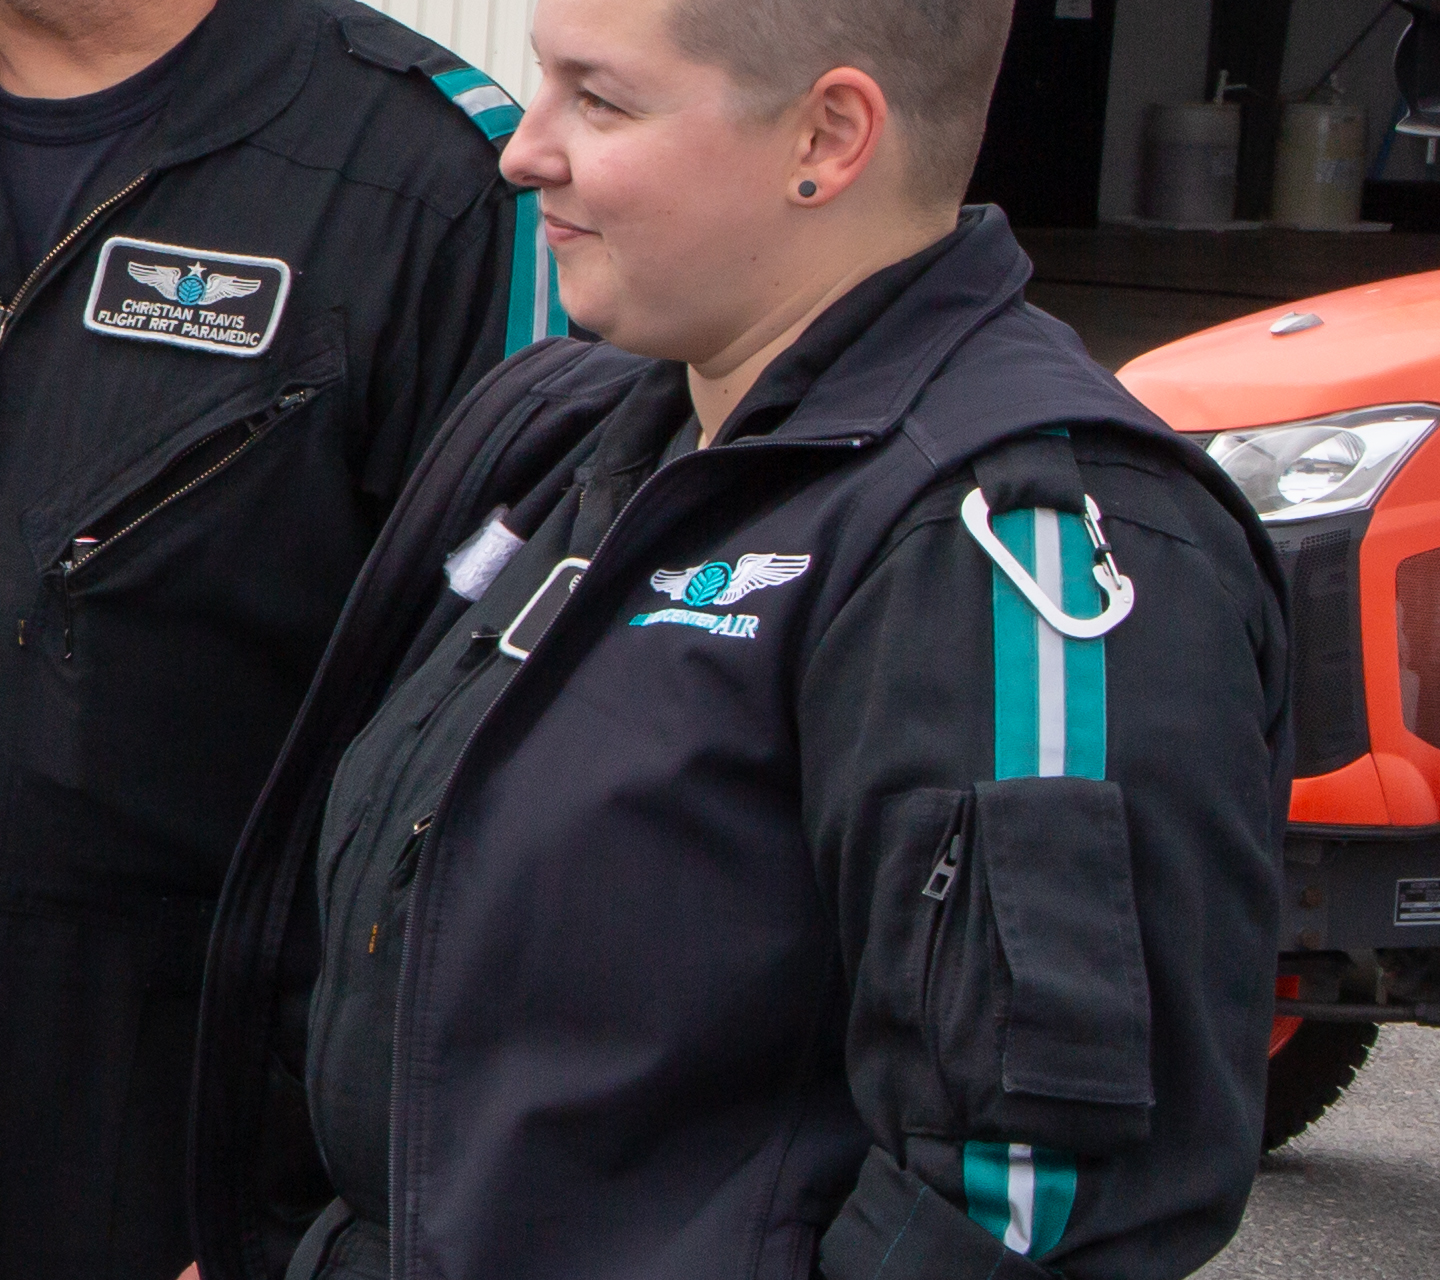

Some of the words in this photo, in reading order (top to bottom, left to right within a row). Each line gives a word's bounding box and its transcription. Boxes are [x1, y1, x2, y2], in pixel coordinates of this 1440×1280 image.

[97, 310, 147, 329] FLIGHT
[149, 317, 178, 332] RRT
[181, 322, 260, 346] PARAMEDIC
[121, 299, 194, 321] CHRISTIAN
[198, 310, 245, 329] TRAVIS
[709, 613, 760, 639] AIR
